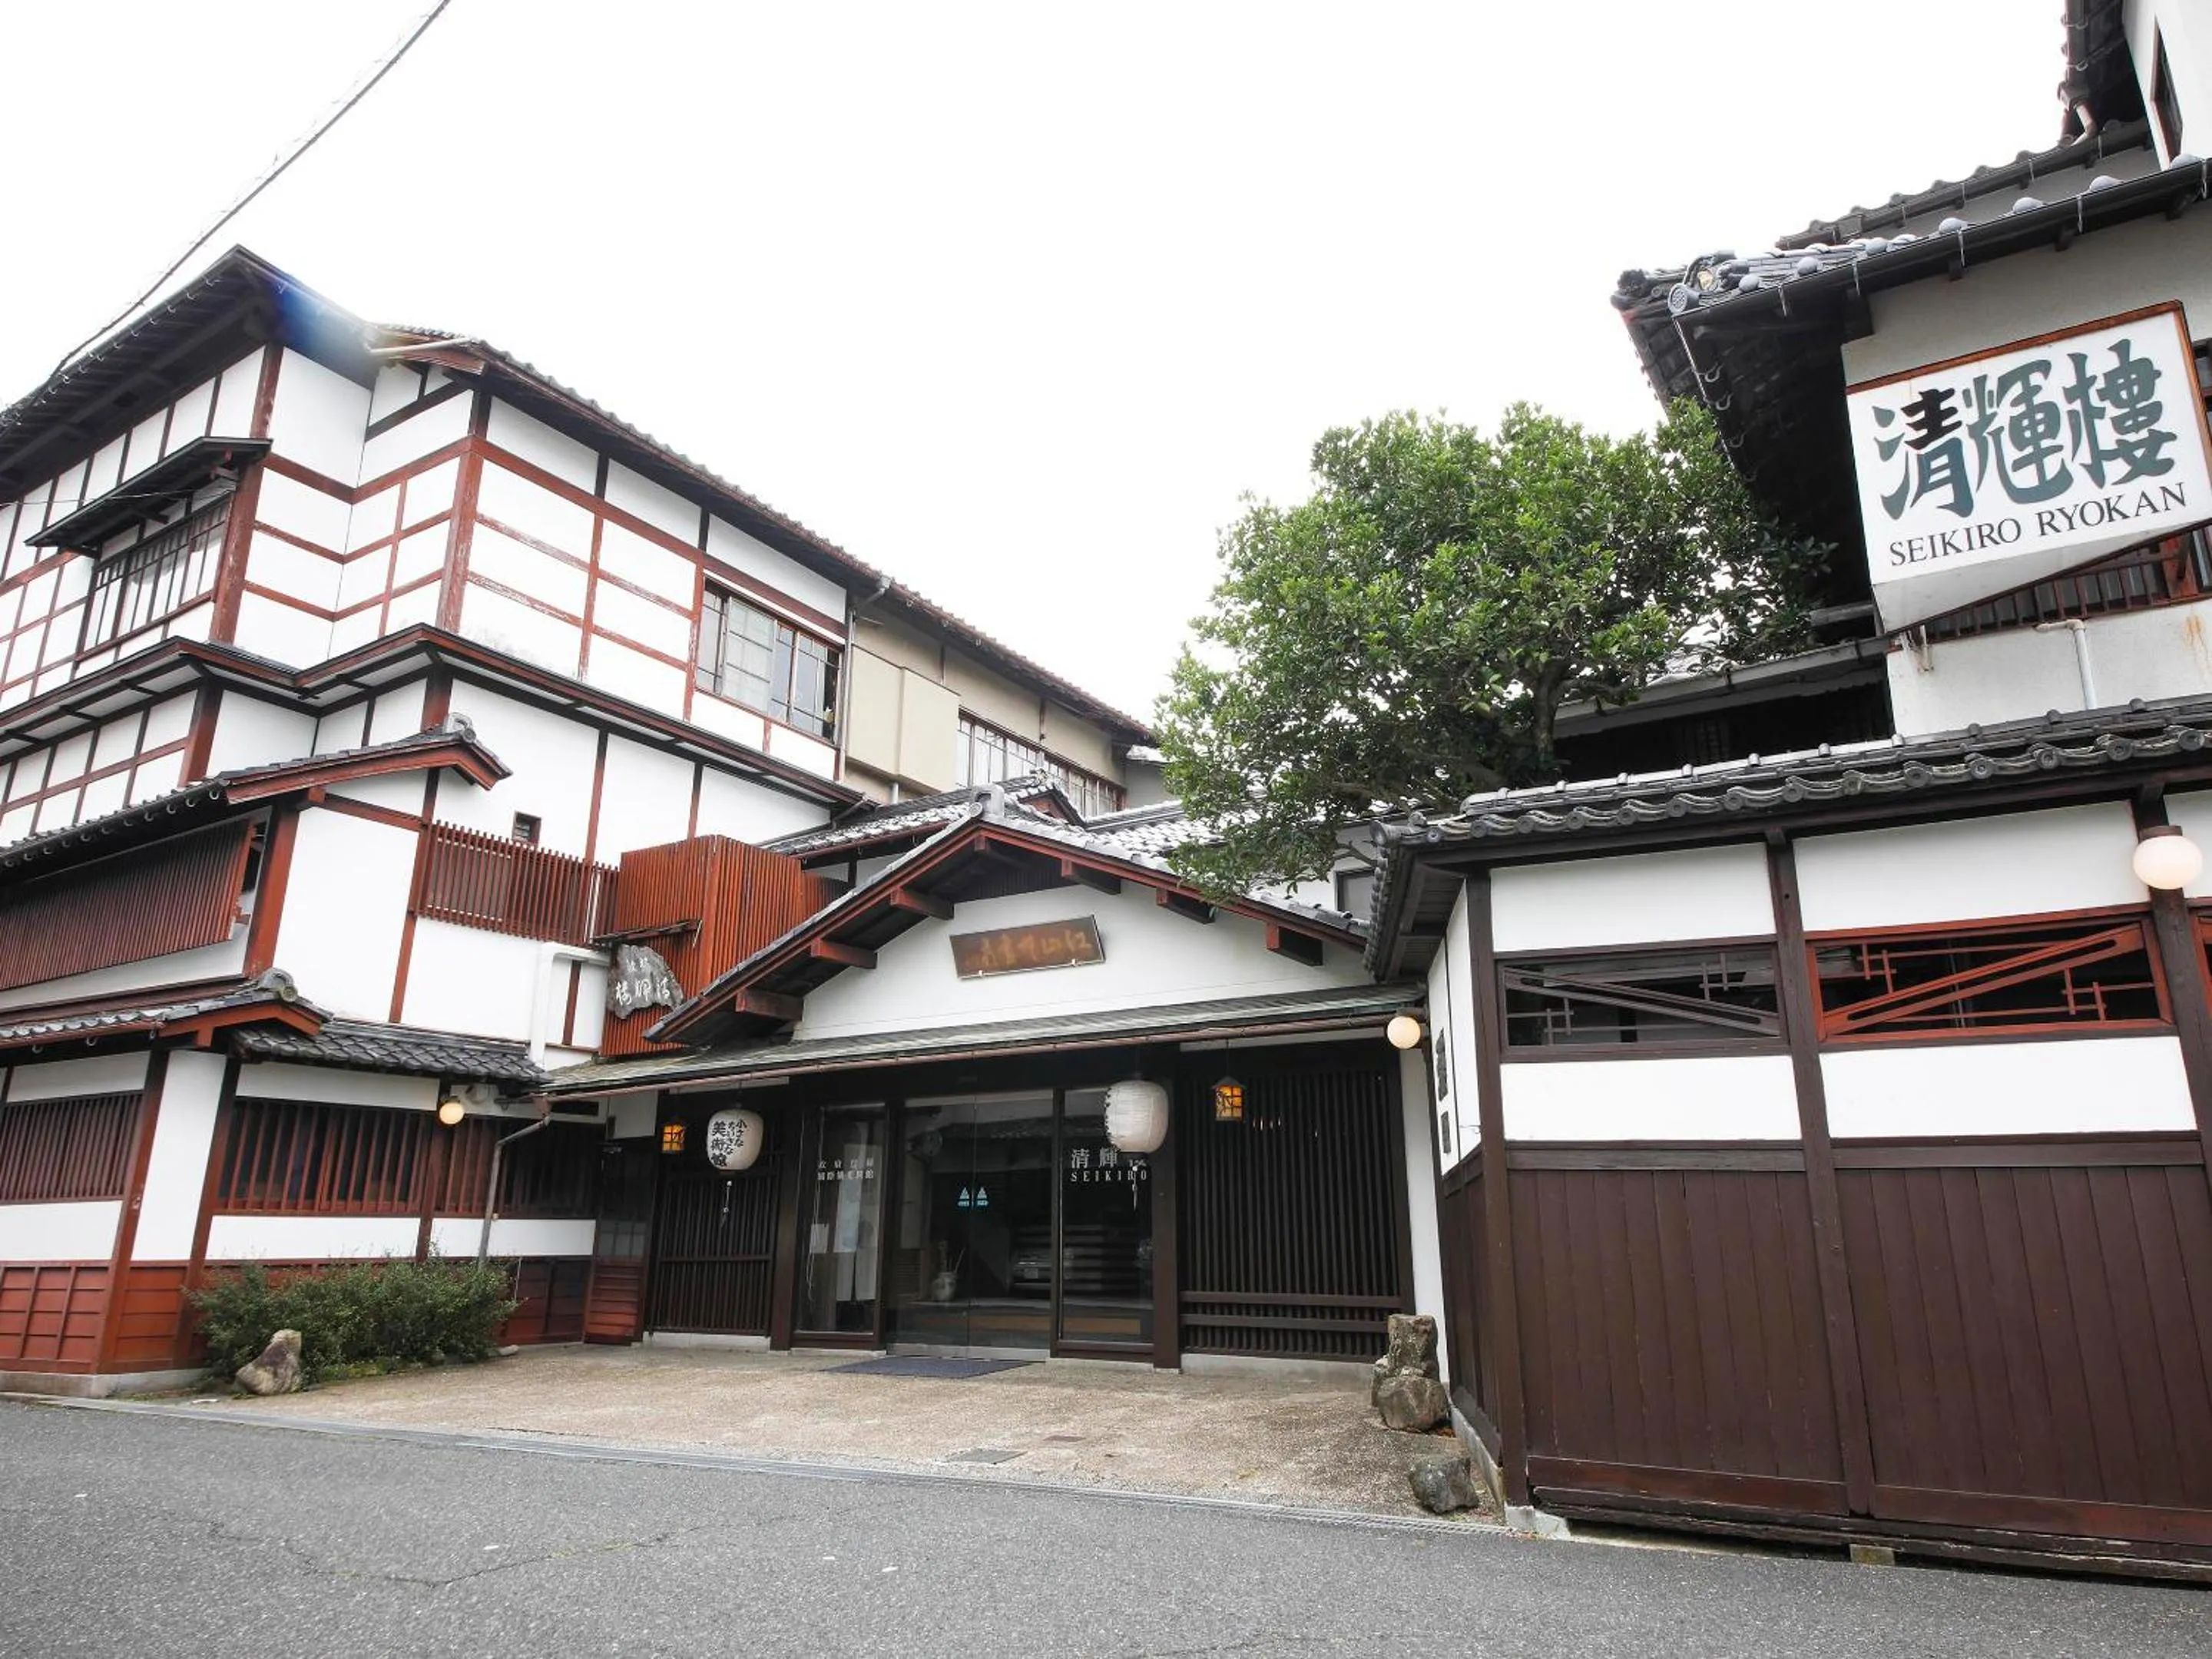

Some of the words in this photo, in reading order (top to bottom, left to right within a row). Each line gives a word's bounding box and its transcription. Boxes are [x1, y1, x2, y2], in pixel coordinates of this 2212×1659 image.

[1889, 518, 2022, 567] SEIKIRO
[2035, 482, 2187, 537] RYOKAN
[1070, 1169, 1147, 1182] SEIKIRO
